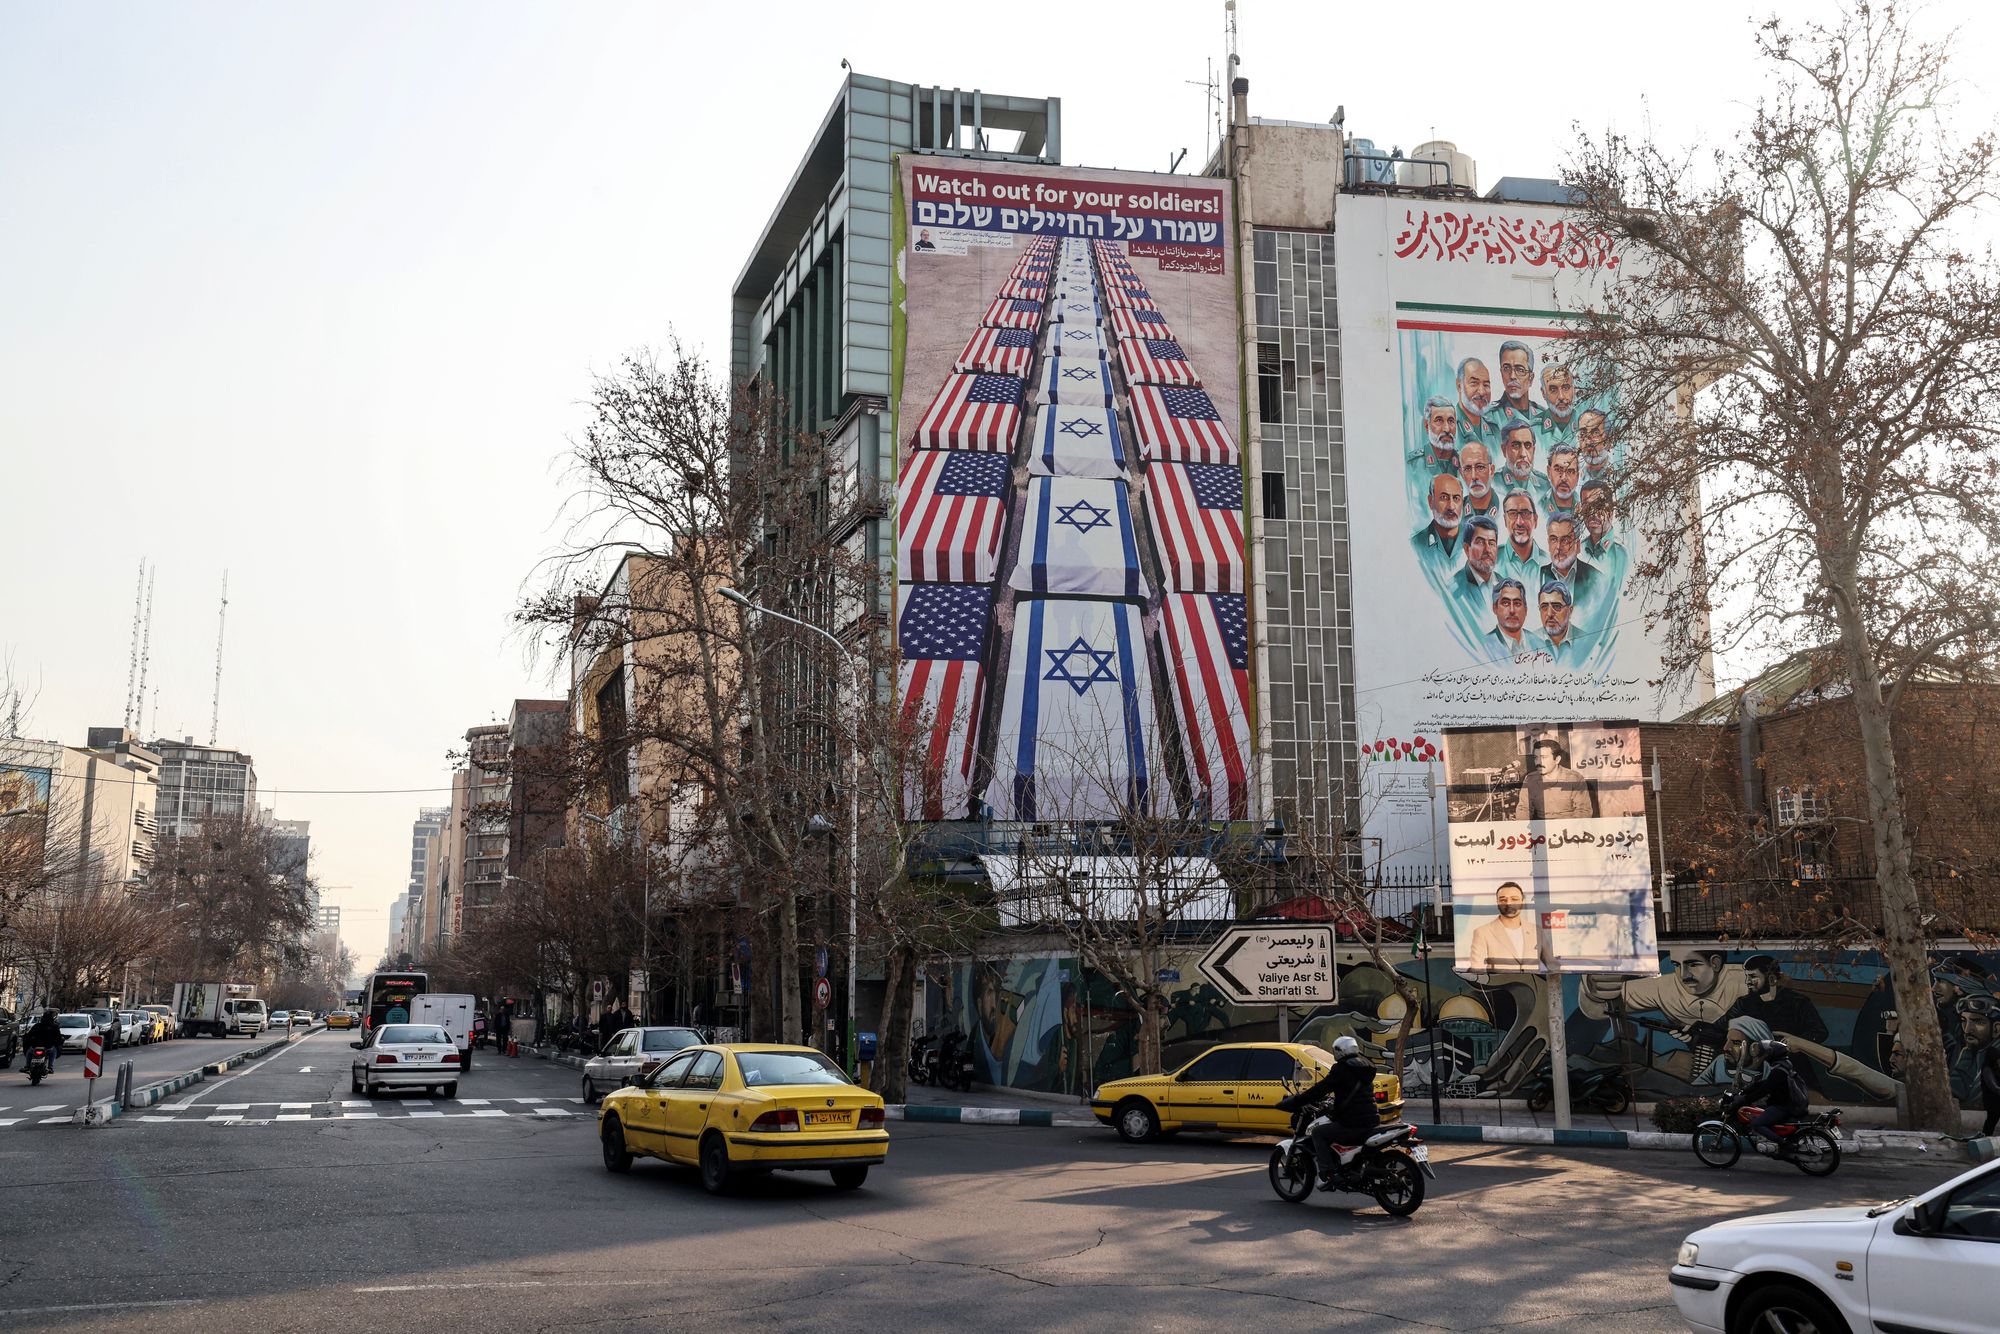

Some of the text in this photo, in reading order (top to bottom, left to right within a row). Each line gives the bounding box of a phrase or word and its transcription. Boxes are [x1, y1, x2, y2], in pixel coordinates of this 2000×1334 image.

[917, 174, 1219, 214] Watch out for your soldiers!
[917, 197, 1217, 243] שמרו על החיילים שלכם
[1132, 243, 1221, 260] مراقب سربازانتان باشید!
[1595, 734, 1624, 749] رادیو
[1576, 753, 1610, 769] آزادی
[1454, 828, 1645, 850] مزدور همان مزدور است
[1611, 853, 1632, 861] ۱۳۶۰
[1268, 934, 1314, 949] ولیعصر
[1266, 952, 1315, 969] شریعتی
[1258, 971, 1328, 984] Valiye Asr St.
[1258, 985, 1319, 995] Shari'ati St.
[1247, 1092, 1264, 1100] ۱۸۸۰
